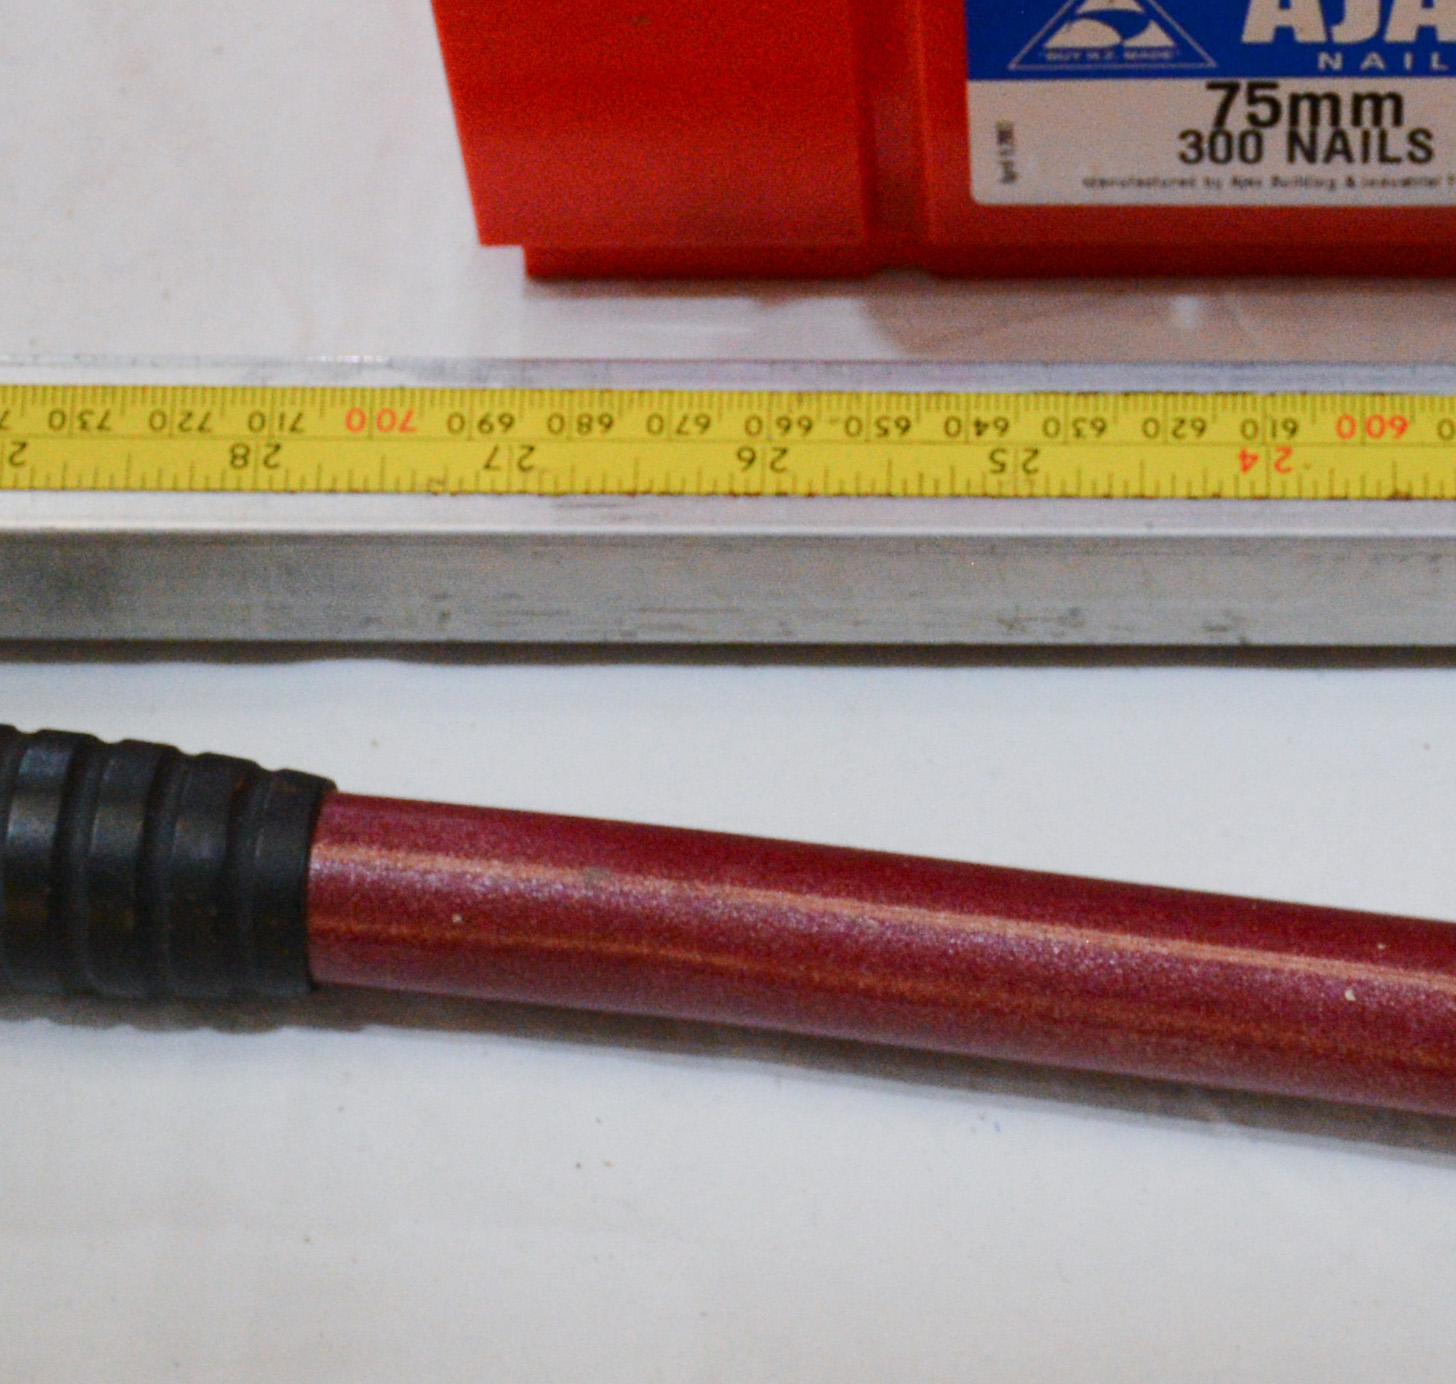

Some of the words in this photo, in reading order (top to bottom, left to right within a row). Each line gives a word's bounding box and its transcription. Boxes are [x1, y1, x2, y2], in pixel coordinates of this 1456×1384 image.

[1205, 81, 1404, 129] 75mm
[1177, 129, 1265, 165] 300
[1287, 127, 1435, 165] NAILS
[228, 442, 283, 470] 28
[481, 445, 536, 473] 27
[736, 445, 790, 474] 26
[988, 447, 1041, 475] 25
[1237, 445, 1294, 474] 24
